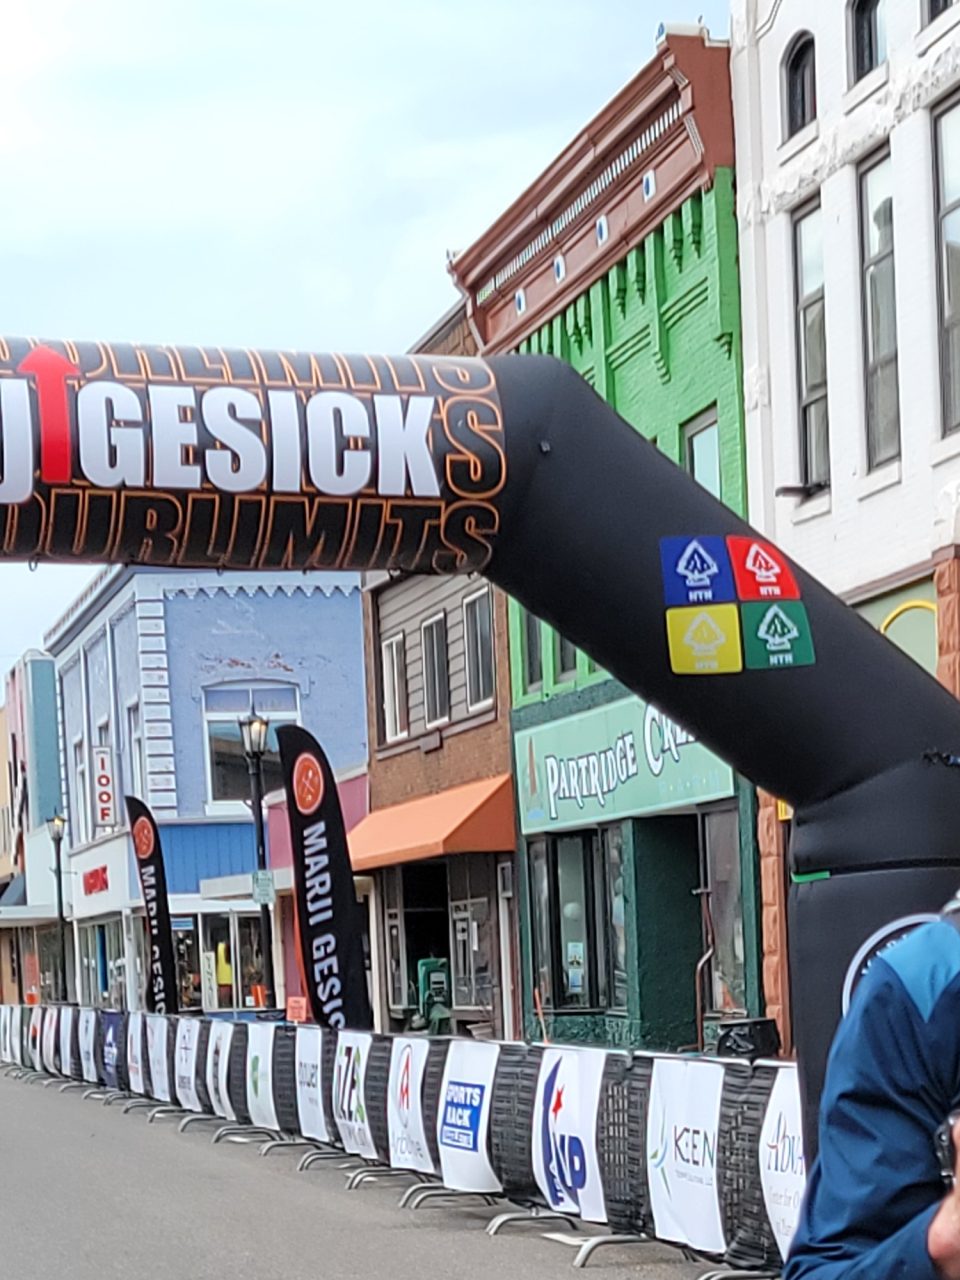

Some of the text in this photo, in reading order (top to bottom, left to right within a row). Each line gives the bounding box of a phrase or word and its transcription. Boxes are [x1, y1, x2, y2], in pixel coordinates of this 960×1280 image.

[176, 490, 499, 574] LIMITS
[98, 757, 112, 821] IOOF
[545, 732, 638, 820] PARTRIDGE
[302, 820, 333, 926] MARJI
[674, 1125, 715, 1168] KEEN
